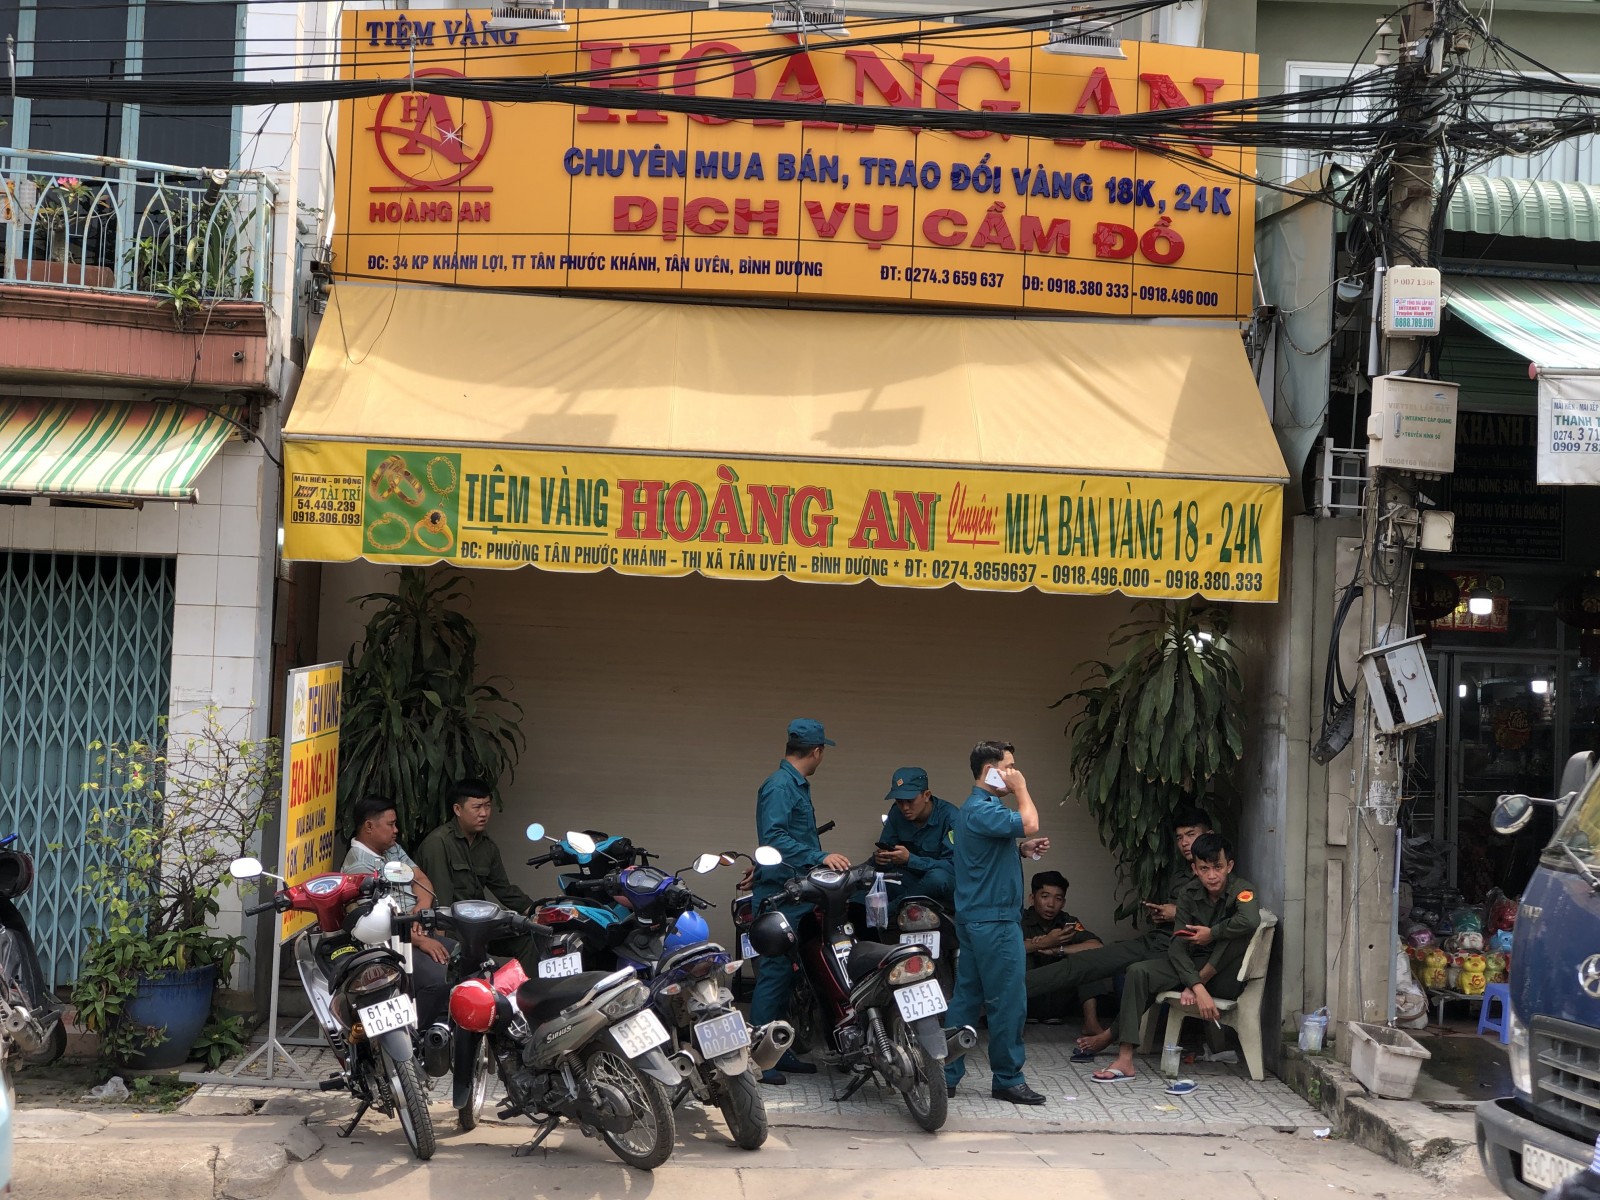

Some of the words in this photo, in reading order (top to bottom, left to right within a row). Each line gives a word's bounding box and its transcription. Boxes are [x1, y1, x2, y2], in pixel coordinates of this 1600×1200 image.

[366, 14, 436, 49] TIỆM
[577, 33, 1020, 141] HOÀNG
[1054, 66, 1225, 158] AN
[563, 144, 686, 178] CHUYÊN
[695, 150, 764, 181] MUA
[778, 148, 849, 190] BÁN,
[859, 157, 942, 190] TRAO
[951, 153, 1002, 194] ĐỔI
[1012, 164, 1094, 202] VÀNG
[1105, 176, 1166, 214] 18K,
[1174, 183, 1232, 216] 24K
[369, 200, 452, 223] HOÀNG
[457, 201, 491, 223] AN
[613, 195, 779, 242] DỊCH
[804, 201, 899, 250] VỤ
[922, 201, 1071, 255] CẦM
[1093, 215, 1185, 265] ĐỒ
[368, 254, 389, 270] ĐC:
[392, 254, 408, 270] 34
[412, 254, 429, 270] KP
[432, 251, 478, 270] KHÁNH
[482, 254, 507, 273] LỢI,
[511, 254, 526, 270] TT
[530, 251, 555, 270] TÂN
[560, 252, 606, 271] PHƯỚC
[610, 252, 660, 273] KHÁNH,
[665, 254, 690, 272] TÂN
[695, 255, 734, 275] UYÊN,
[739, 256, 771, 275] BÌNH
[775, 260, 823, 277] DƯƠNG
[880, 265, 901, 281] ĐT:
[953, 270, 977, 287] 659
[980, 272, 1004, 288] 637
[1022, 275, 1044, 291] DĐ:
[1047, 277, 1102, 296] 0918.380
[1106, 283, 1129, 299] 333
[1196, 291, 1218, 306] 000
[1554, 415, 1592, 427] THANH
[1578, 427, 1584, 441] 3
[1553, 442, 1581, 452] 0909
[320, 485, 339, 500] TÀI
[342, 486, 361, 501] TRÍ
[292, 510, 361, 525] 0918.306.093
[297, 499, 356, 512] 54.449.239
[465, 464, 531, 535] TIỆM
[540, 465, 609, 528] VÀNG
[614, 463, 838, 549] HOÀNG
[848, 489, 942, 552] AN
[1004, 492, 1050, 556] MUA
[1057, 480, 1102, 558] BÁN
[1108, 482, 1164, 562] VÀNG
[1173, 500, 1199, 564] 18
[1220, 501, 1263, 564] 24K
[461, 541, 482, 559] ĐC:
[486, 540, 539, 562] PHƯỜNG
[544, 542, 570, 563] TÂN
[574, 543, 618, 565] PHƯỚC
[622, 544, 667, 567] KHÁNH
[706, 548, 723, 569] XÃ
[729, 549, 755, 571] TÂN
[760, 551, 797, 573] UYÊN
[811, 552, 841, 575] BÌNH
[845, 555, 888, 577] DƯƠNG
[904, 560, 927, 579] ĐT:
[931, 562, 1036, 583] 0274.3659637
[1052, 566, 1150, 588] 0918.496.000
[1165, 569, 1263, 592] 0918.380.333
[290, 743, 322, 809] HOÀNG
[322, 747, 336, 796] AN
[545, 956, 573, 974] 61-E1
[901, 983, 934, 1004] 61-E1
[366, 998, 402, 1020] 61-N1
[902, 996, 944, 1019] 347.33
[367, 1009, 410, 1034] 104.87
